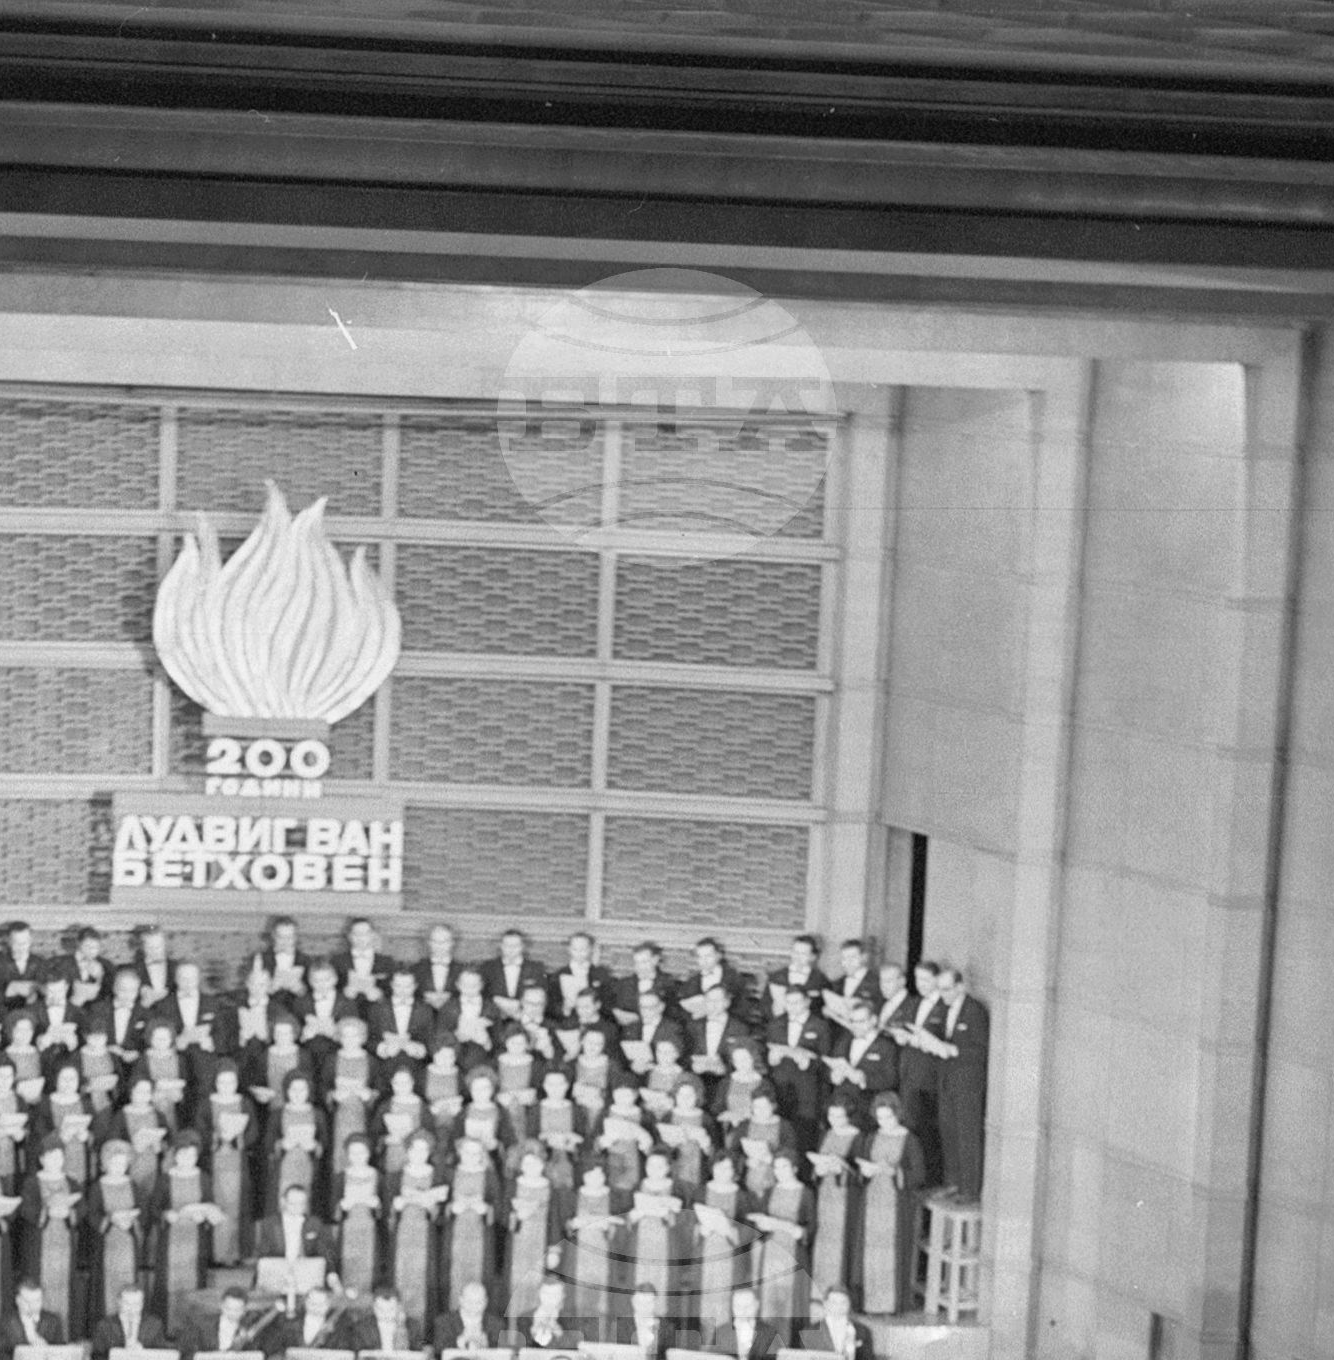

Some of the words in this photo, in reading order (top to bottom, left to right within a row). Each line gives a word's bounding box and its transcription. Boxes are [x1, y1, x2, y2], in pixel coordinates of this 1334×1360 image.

[206, 737, 331, 777] 200
[117, 815, 298, 853] ЛУДВИГ
[308, 818, 404, 856] ВАН
[114, 854, 403, 891] БЕТХОВЕН
